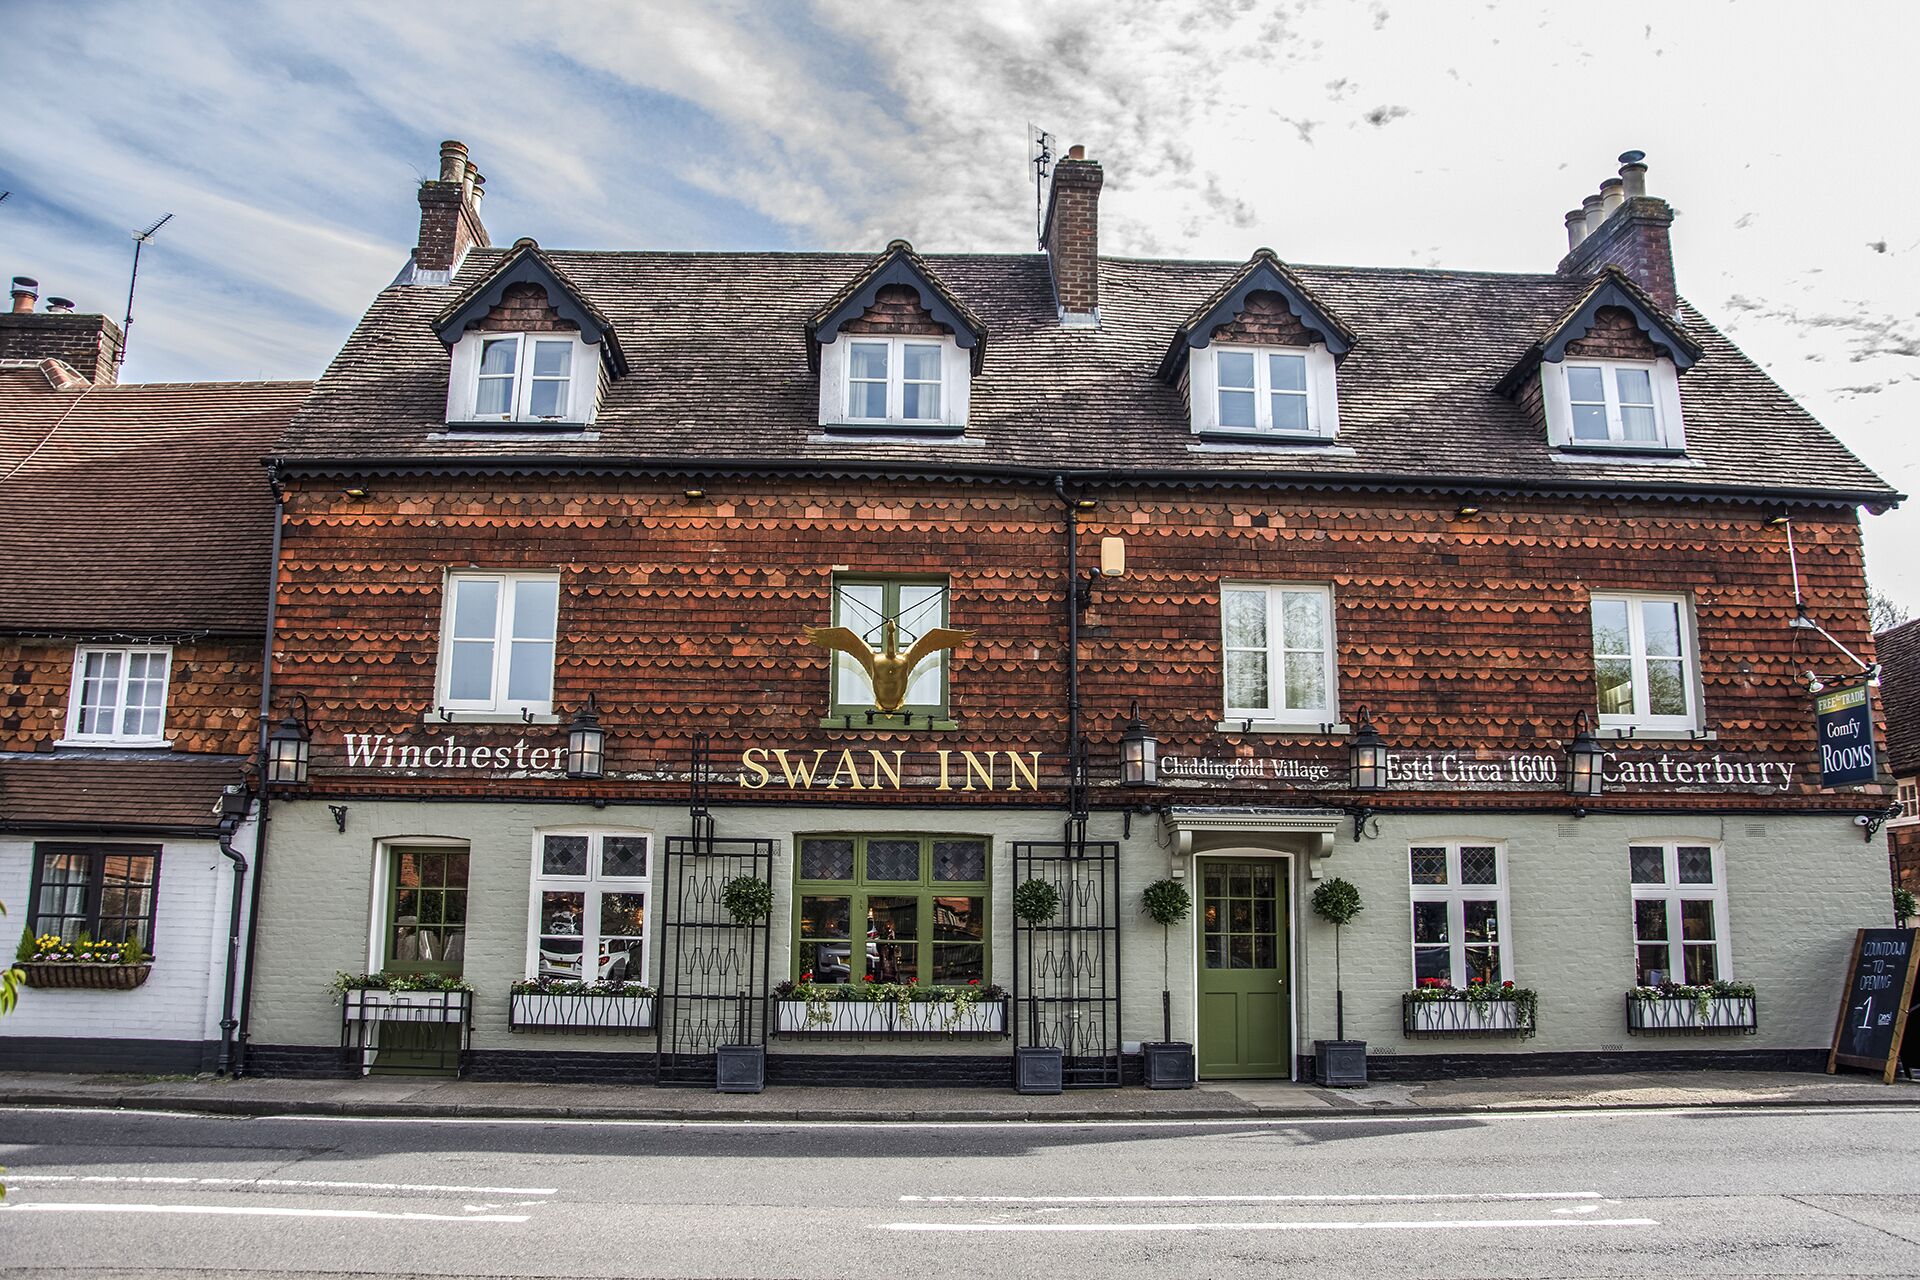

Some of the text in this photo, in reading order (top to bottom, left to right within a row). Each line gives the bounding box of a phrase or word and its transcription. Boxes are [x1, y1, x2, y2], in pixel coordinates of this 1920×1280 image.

[1840, 689, 1866, 705] TRADE
[1827, 718, 1860, 738] Comfy
[343, 733, 569, 770] Winchester
[1822, 744, 1872, 774] ROOMS
[739, 748, 1043, 792] SWAN INN
[1161, 756, 1329, 781] Chiddingfold Village
[1441, 754, 1502, 782] Circa
[1508, 754, 1557, 782] 1600
[1602, 752, 1796, 790] Canterbury
[1863, 941, 1907, 956] COUNTDOWN
[1859, 974, 1892, 991] OPENING
